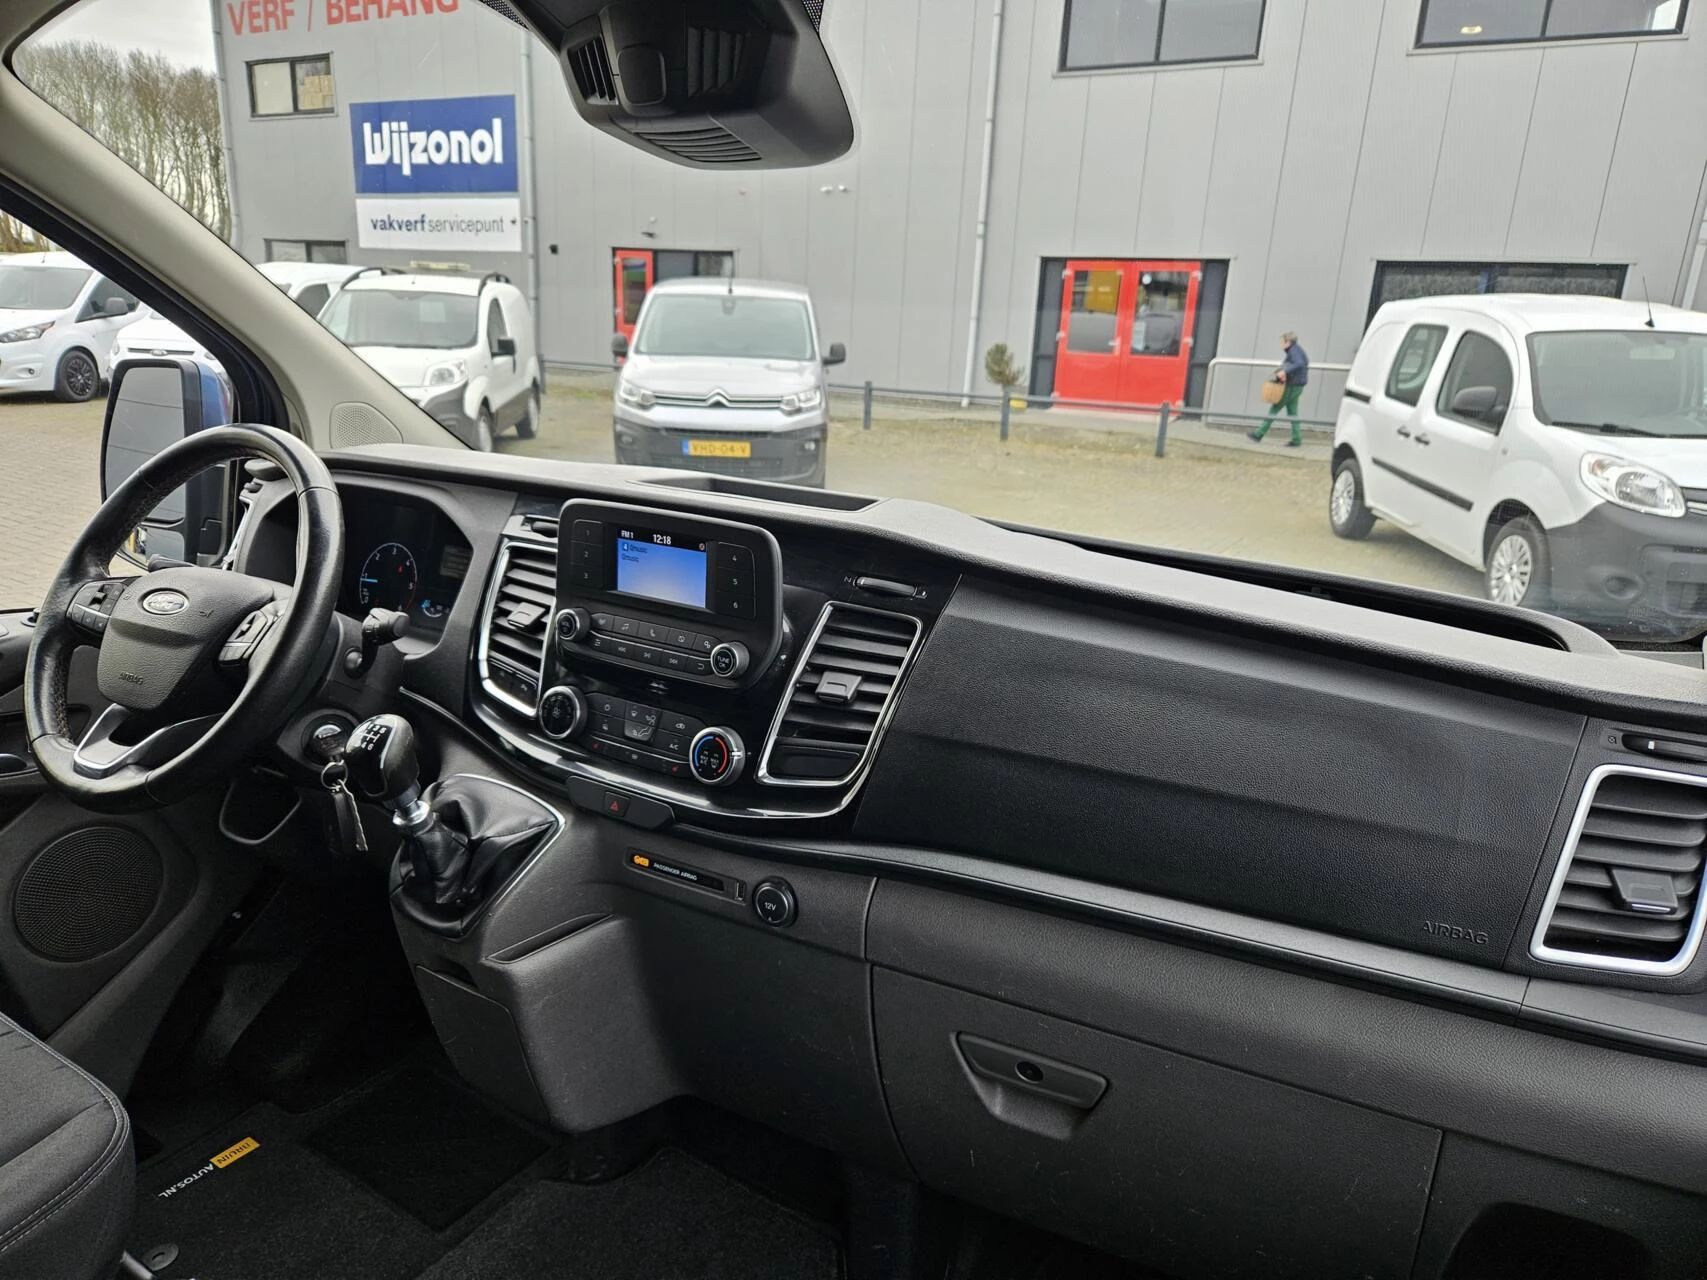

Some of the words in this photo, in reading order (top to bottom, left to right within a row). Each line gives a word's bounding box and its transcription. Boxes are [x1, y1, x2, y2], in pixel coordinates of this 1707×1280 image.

[226, 0, 295, 36] VERF
[363, 117, 504, 177] Wijzonol
[653, 533, 672, 545] 12:18
[733, 601, 738, 609] 6
[118, 670, 144, 686] AIRBAG
[367, 743, 375, 751] 6
[653, 862, 681, 875] PASSENGER
[680, 871, 698, 881] AIRBAG
[764, 901, 777, 911] 12V
[1422, 920, 1489, 945] AIRBAG
[216, 1142, 251, 1164] BRUIN
[157, 1162, 214, 1198] AUTOS.NL
